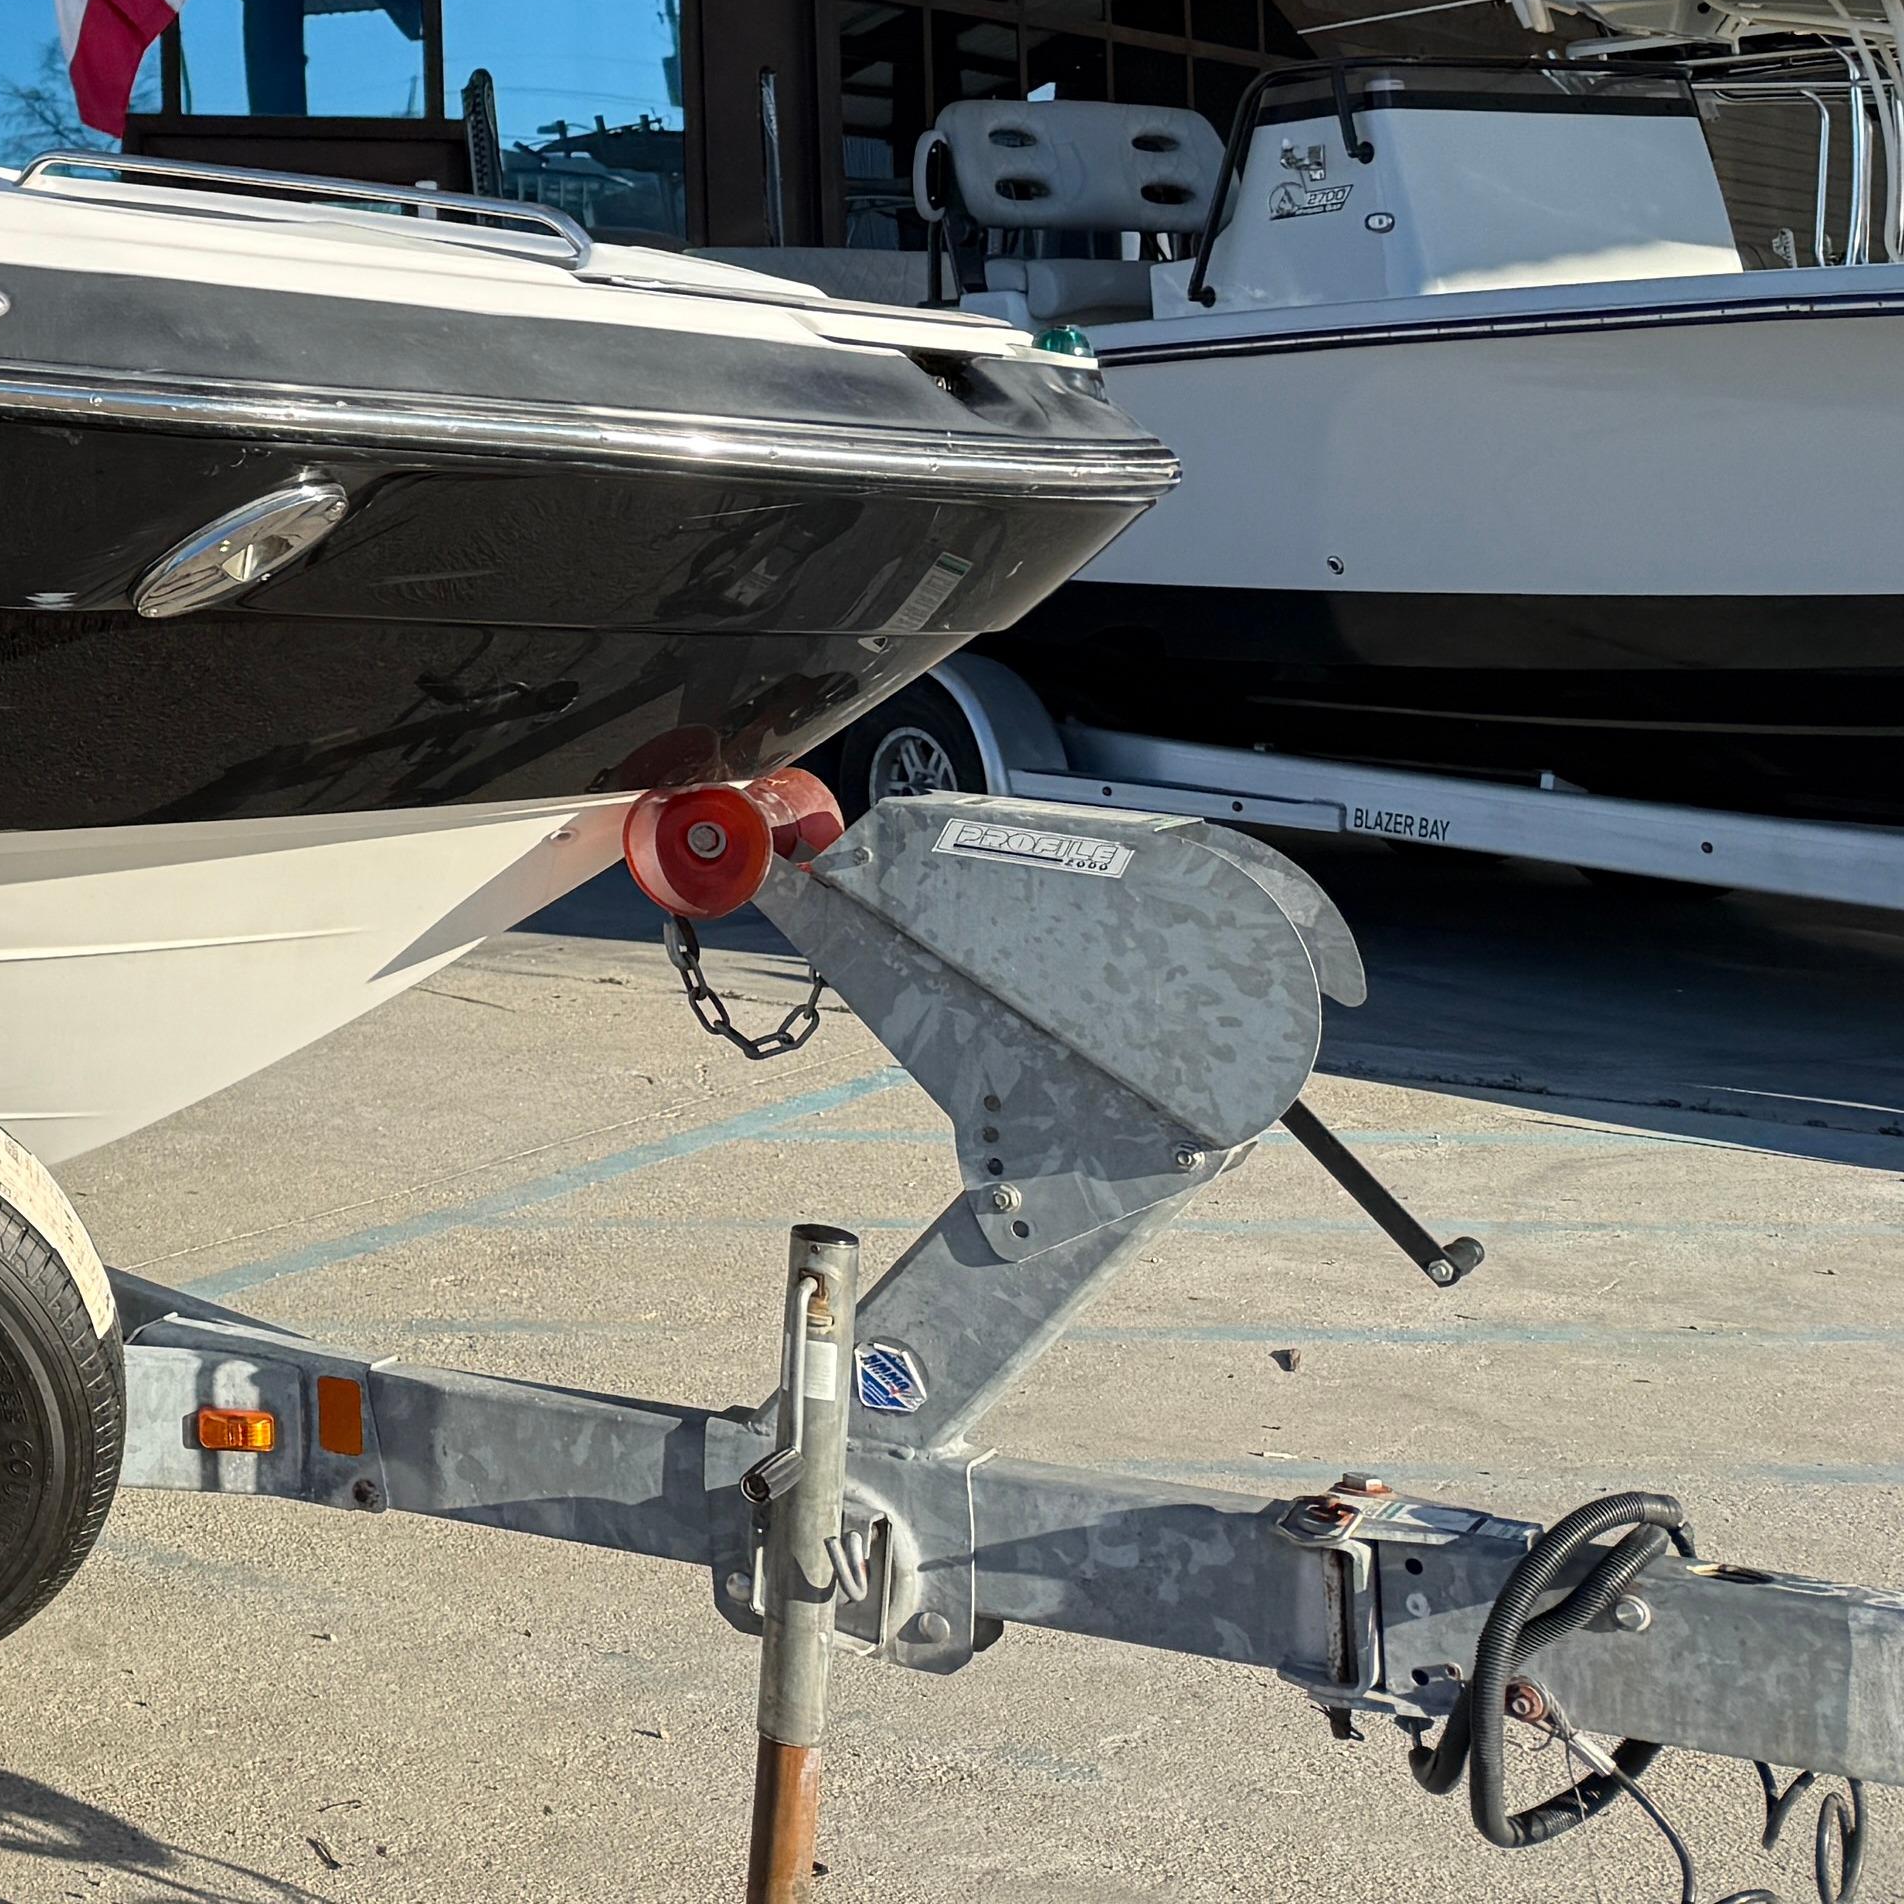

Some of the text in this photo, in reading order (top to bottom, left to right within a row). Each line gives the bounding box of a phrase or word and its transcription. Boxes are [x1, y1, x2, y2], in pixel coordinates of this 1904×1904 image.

[1307, 188, 1346, 205] 2700
[1354, 807, 1450, 841] BLAZER BAY
[956, 825, 1118, 865] PROFILE
[1065, 858, 1109, 871] 2000
